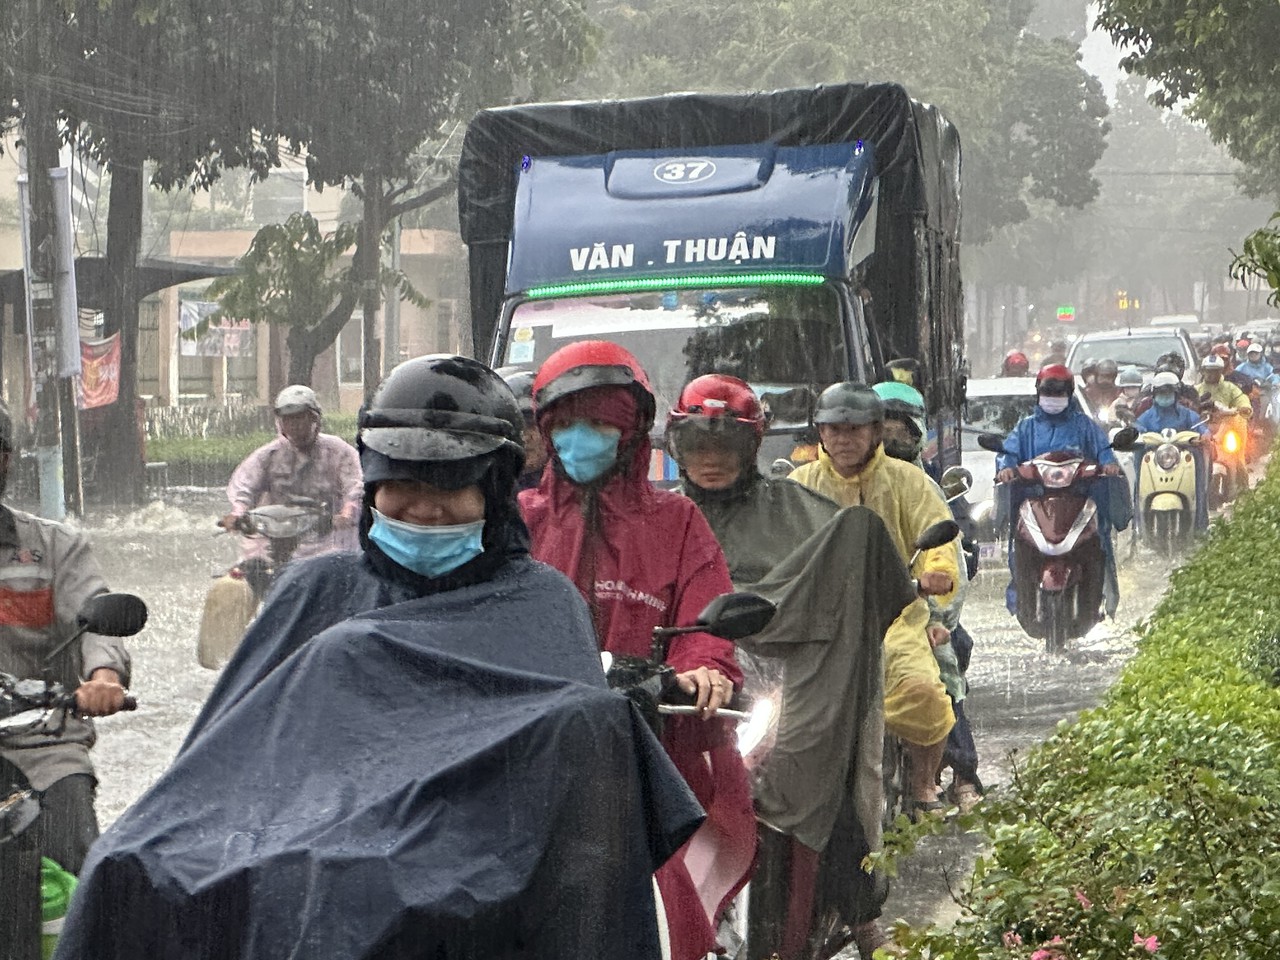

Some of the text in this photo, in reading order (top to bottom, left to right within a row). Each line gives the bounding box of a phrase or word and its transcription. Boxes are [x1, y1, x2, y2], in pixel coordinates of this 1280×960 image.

[662, 162, 705, 181] 37
[569, 242, 635, 271] VĂN
[663, 231, 776, 265] THUẬN
